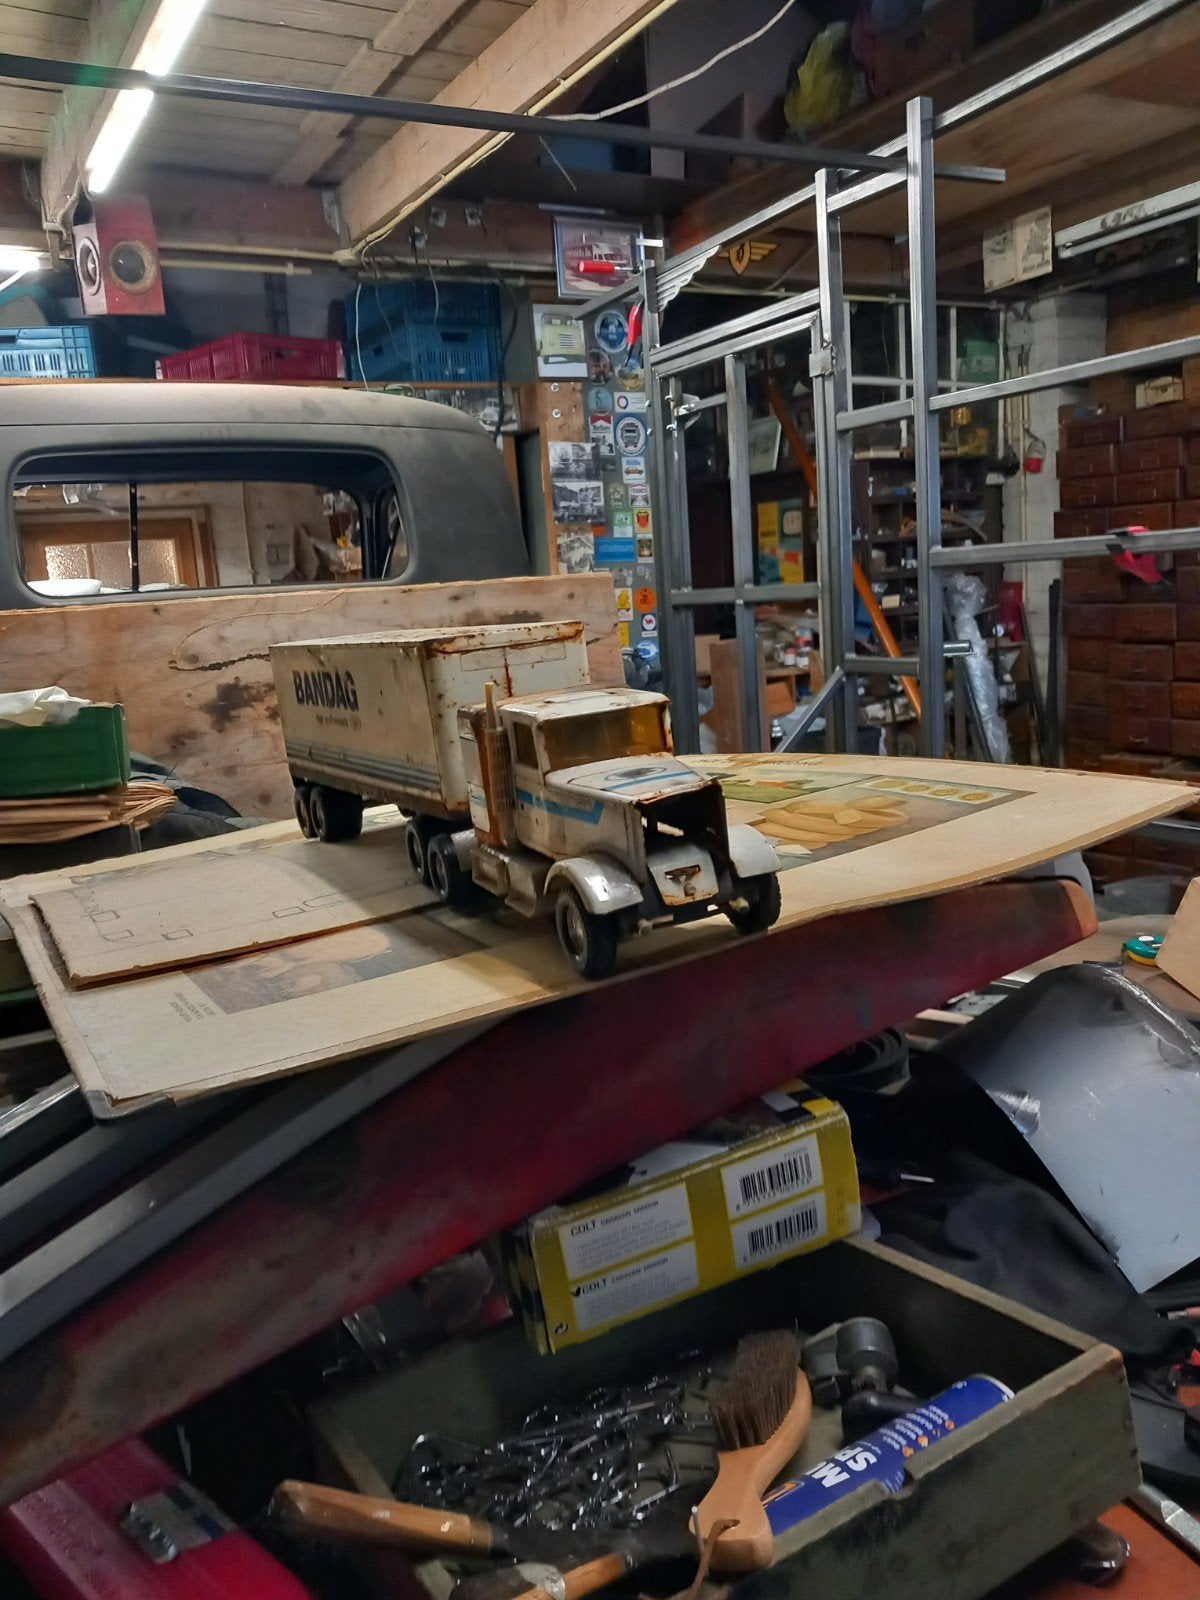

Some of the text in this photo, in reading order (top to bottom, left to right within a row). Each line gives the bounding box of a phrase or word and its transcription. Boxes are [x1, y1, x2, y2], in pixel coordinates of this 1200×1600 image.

[292, 669, 359, 711] BANDAG
[571, 1220, 596, 1237] COLT
[582, 1278, 606, 1295] COLT
